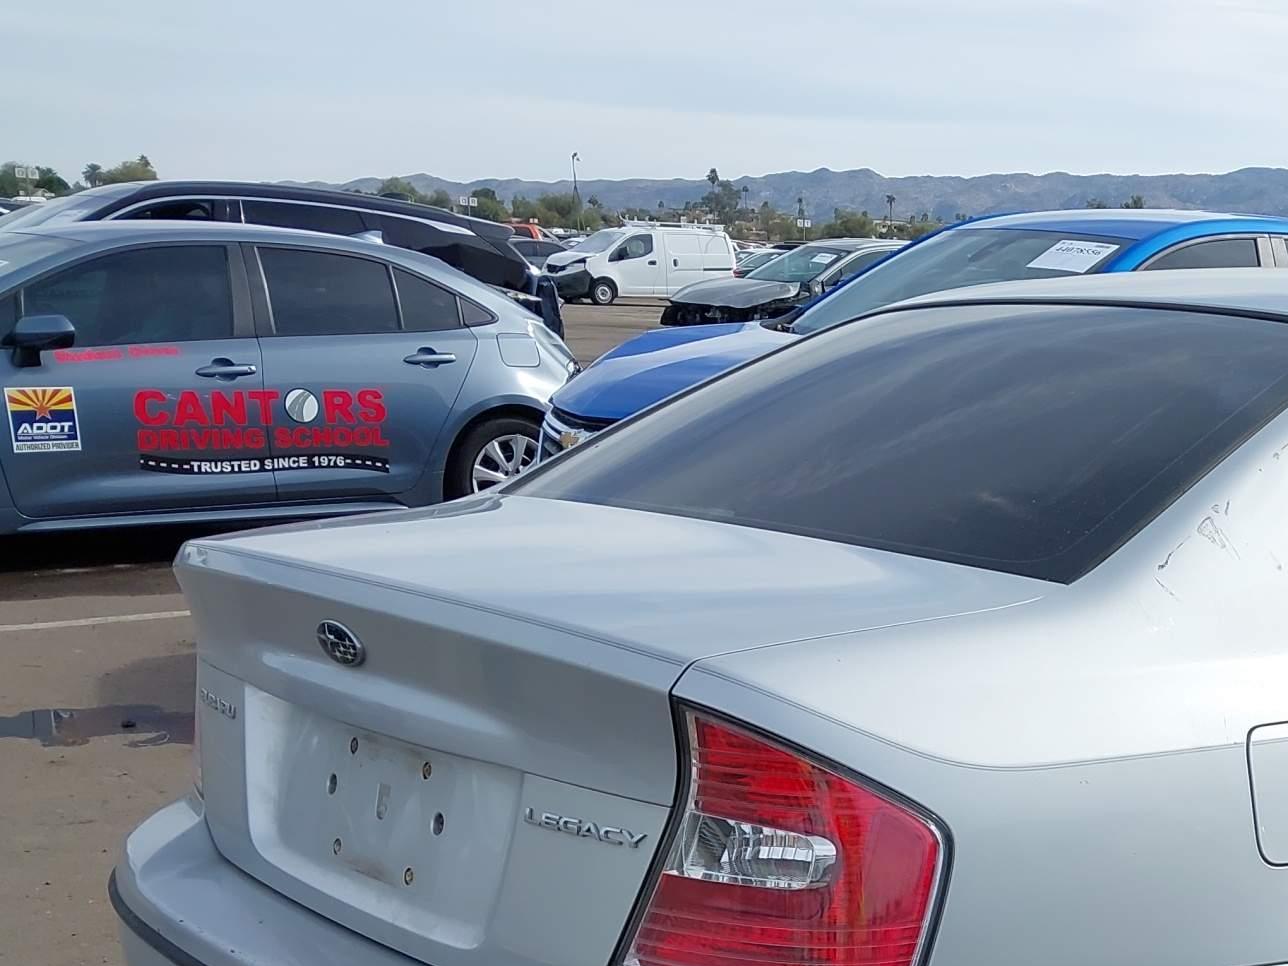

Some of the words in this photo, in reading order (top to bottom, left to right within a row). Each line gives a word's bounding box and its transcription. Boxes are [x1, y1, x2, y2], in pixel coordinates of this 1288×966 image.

[17, 422, 73, 433] ADOT
[16, 442, 51, 452] AUTHORIZED
[51, 441, 80, 450] PROVIDER
[137, 428, 266, 451] DRIVING
[273, 426, 390, 449] SCHOOL
[191, 460, 260, 473] TRUSTED
[264, 458, 308, 470] SINCE
[312, 456, 346, 468] 1976
[524, 807, 649, 849] LEGACY
